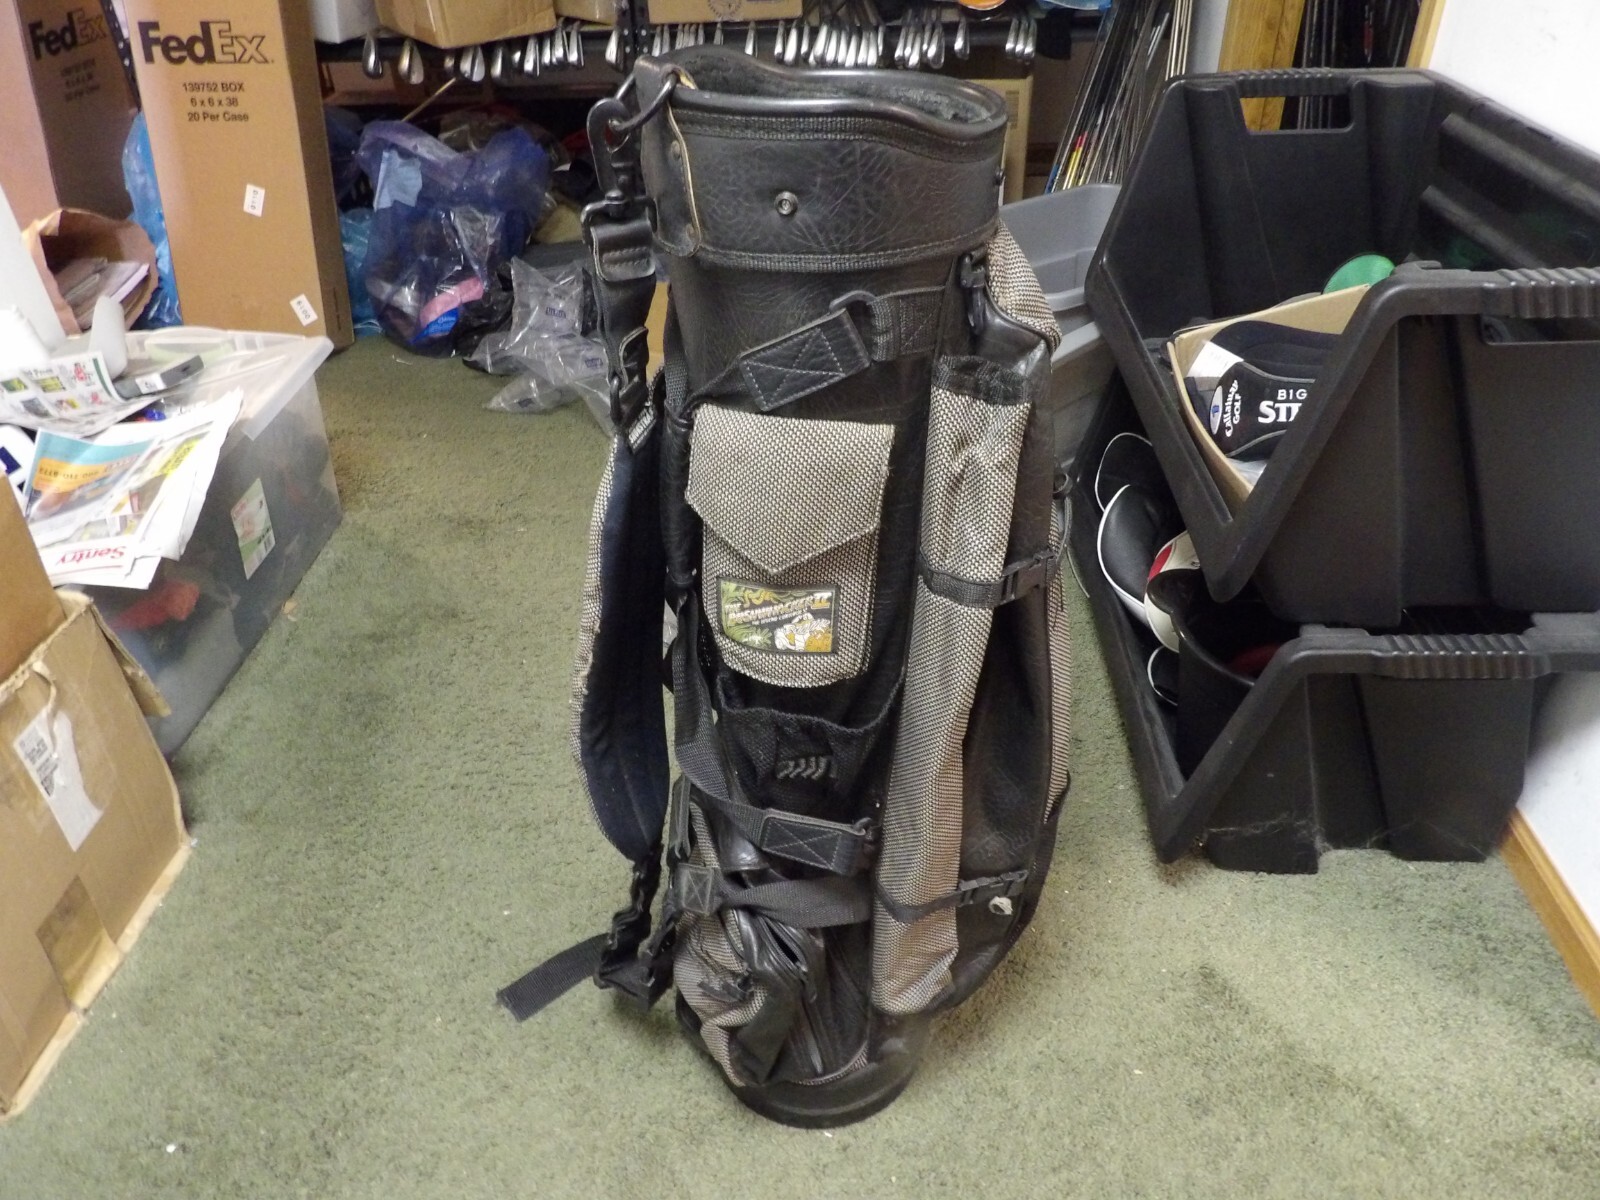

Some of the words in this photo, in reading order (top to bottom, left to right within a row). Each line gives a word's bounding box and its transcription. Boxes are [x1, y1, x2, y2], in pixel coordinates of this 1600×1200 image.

[28, 7, 108, 61] FedEx
[182, 81, 219, 93] 139752
[220, 81, 245, 93] BOX
[190, 97, 198, 107] 6
[208, 97, 215, 107] 6
[187, 111, 200, 122] 20
[201, 111, 220, 122] Per
[222, 111, 249, 122] Case
[1276, 388, 1308, 401] BIG
[1232, 393, 1242, 425] GOLF
[55, 545, 127, 565] Sentry
